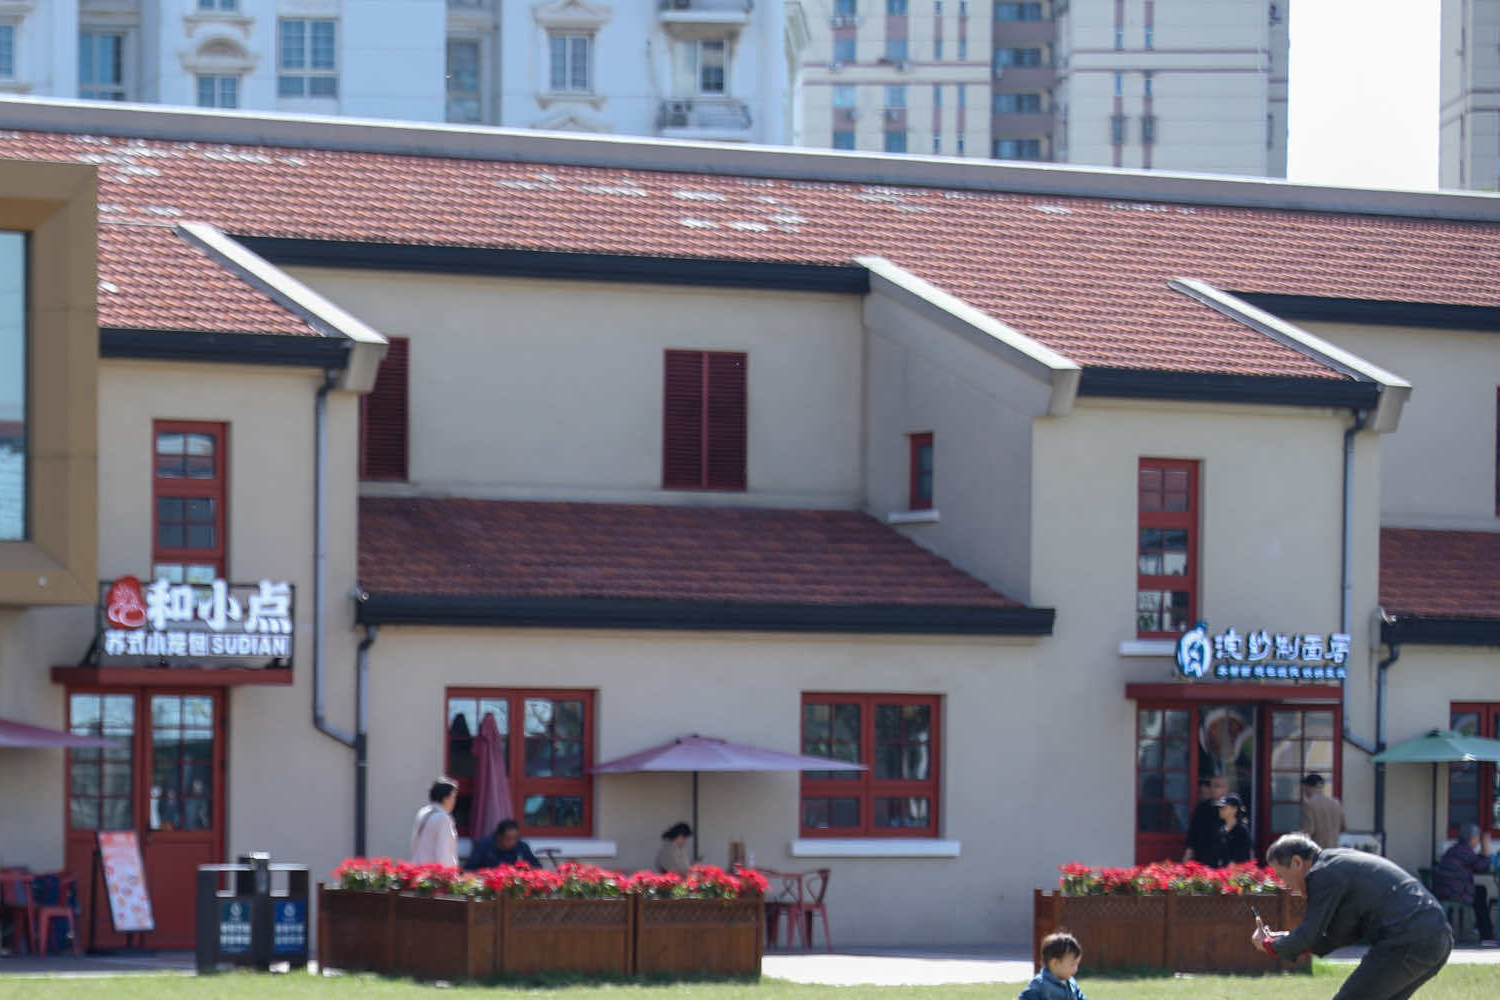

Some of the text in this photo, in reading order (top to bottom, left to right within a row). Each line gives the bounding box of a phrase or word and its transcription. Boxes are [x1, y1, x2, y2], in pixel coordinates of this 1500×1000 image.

[146, 577, 293, 633] 和小点
[211, 636, 287, 656] SUDIAN
